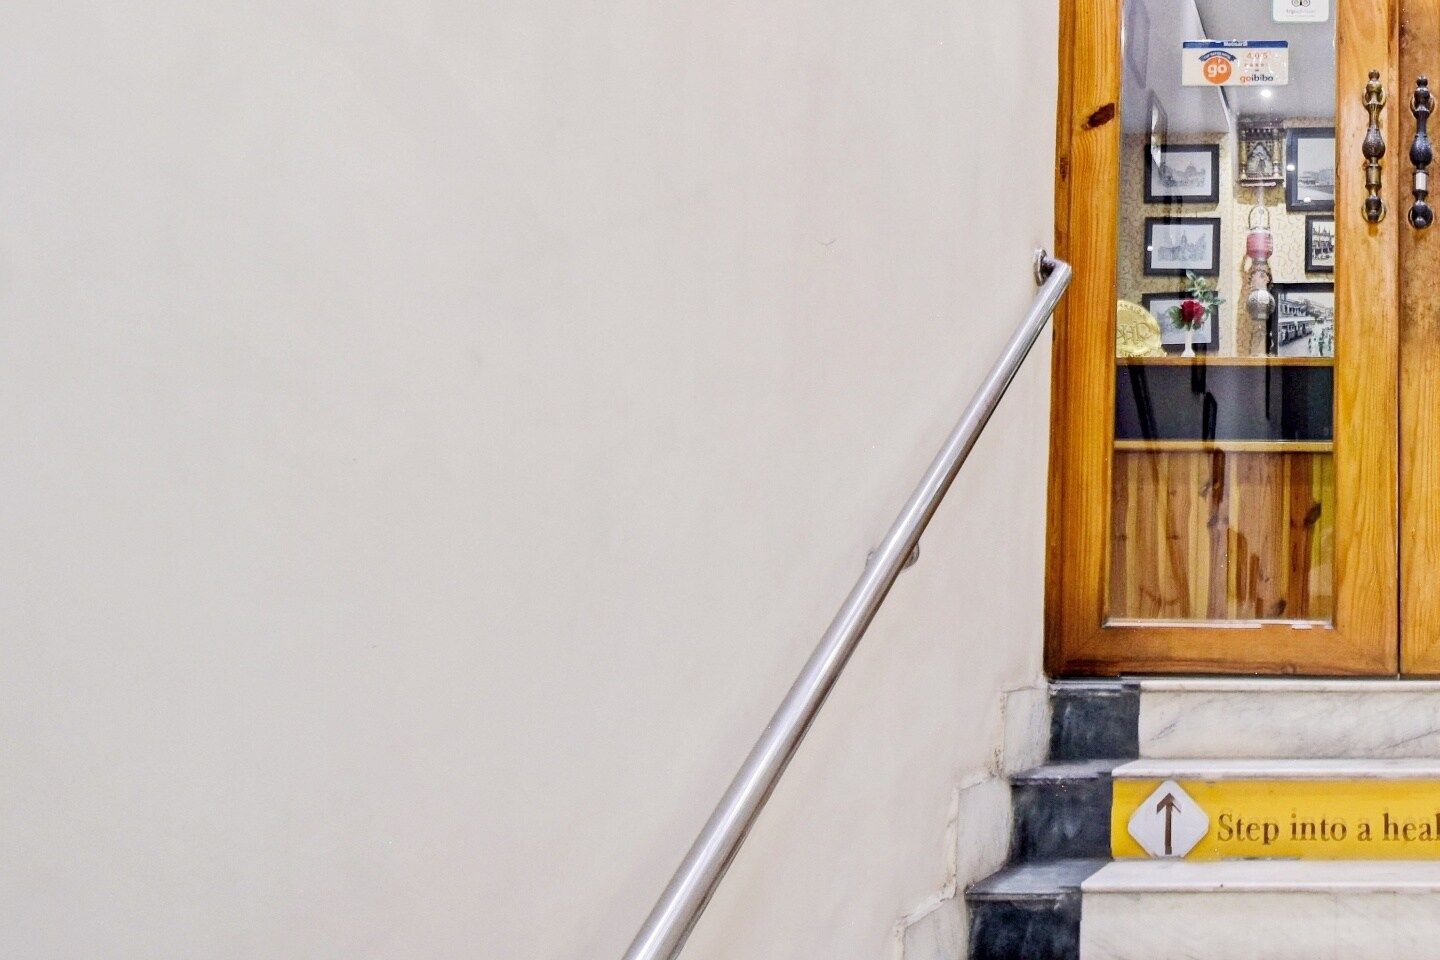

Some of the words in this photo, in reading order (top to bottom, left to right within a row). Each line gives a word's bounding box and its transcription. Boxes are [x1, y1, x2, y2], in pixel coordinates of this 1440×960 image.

[1207, 63, 1228, 78] go
[1239, 74, 1274, 83] goibibo
[1217, 813, 1280, 845] Step
[1290, 812, 1348, 842] into
[1357, 822, 1373, 842] a
